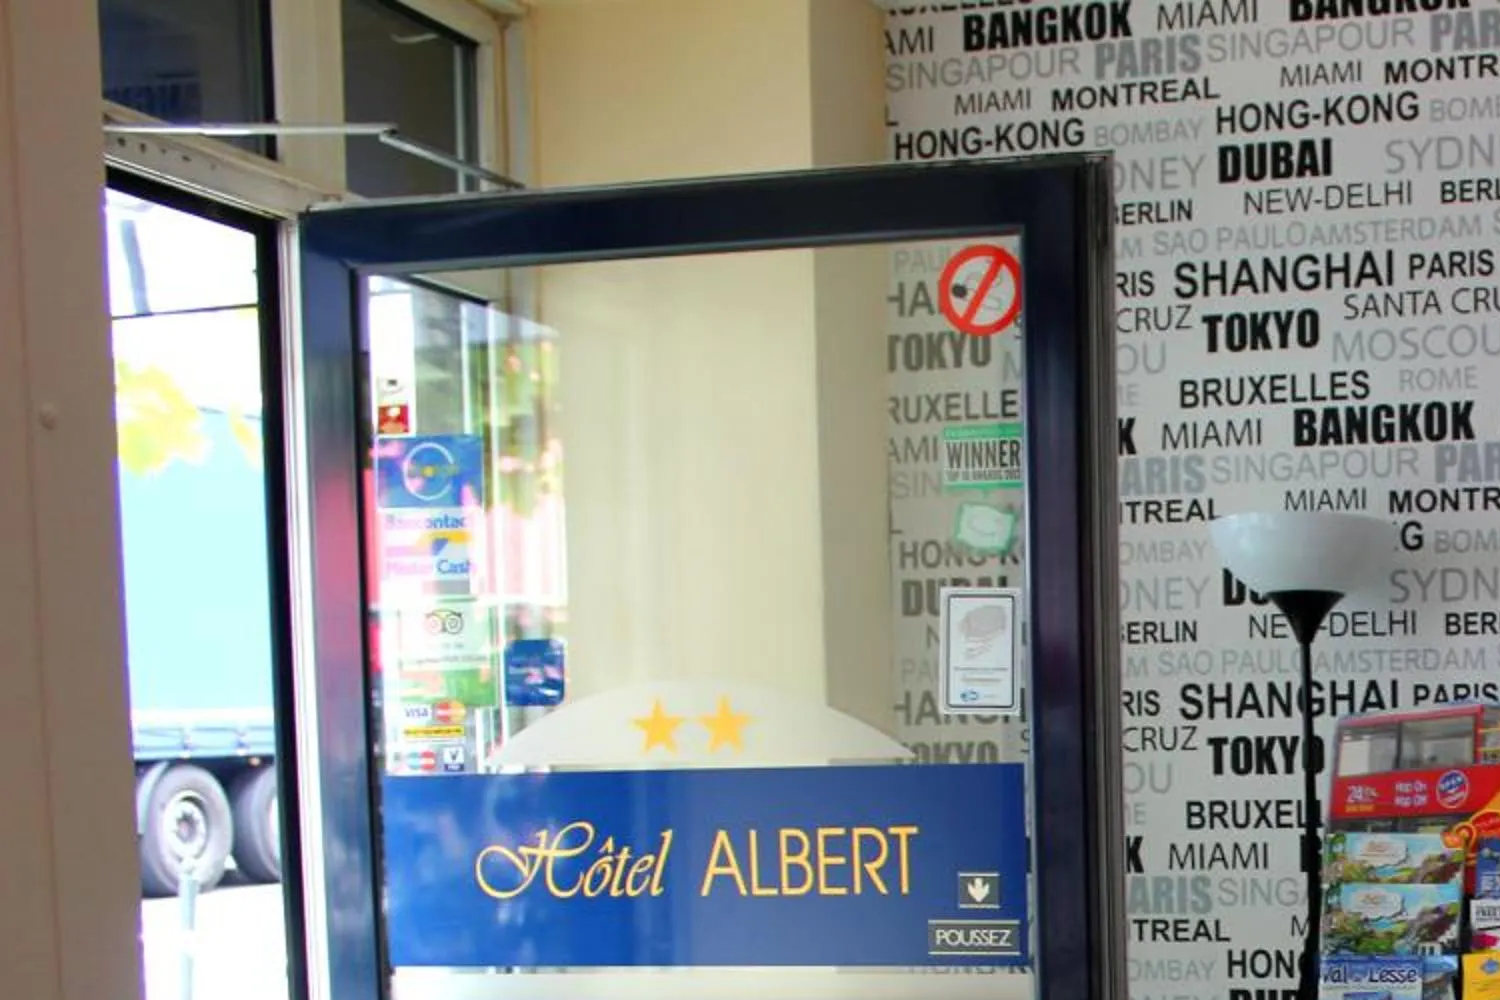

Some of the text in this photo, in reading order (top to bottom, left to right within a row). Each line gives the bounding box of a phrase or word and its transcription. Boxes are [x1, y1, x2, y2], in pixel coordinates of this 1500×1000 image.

[962, 3, 1132, 52] BANGKOK
[885, 34, 1202, 92] SINGAPOUR PARIS
[954, 87, 1032, 116] MIAMI
[1051, 78, 1220, 112] MONTREAL
[894, 118, 1085, 160] HONG-KONG
[1215, 93, 1419, 134] HONG-KONG
[1218, 138, 1332, 184] DUBAI
[1243, 180, 1412, 215] NEW-DELHI
[1173, 250, 1393, 300] SHANGHAI
[1408, 249, 1494, 280] PARIS
[1202, 309, 1319, 354] TOKYO
[1179, 371, 1370, 409] BRUXELLES
[1400, 366, 1478, 393] ROME
[1162, 402, 1475, 448] MIAMI BANGKOK
[946, 440, 1020, 468] WINNER
[1210, 446, 1419, 485] SINGAPOUR
[1285, 488, 1367, 513] MIAMI
[1180, 678, 1399, 723] SHANGHAI
[1208, 734, 1325, 777] TOKYO
[475, 821, 919, 898] Hôtel ALBERT
[1169, 842, 1269, 871] MIAMI
[934, 928, 1011, 947] POUSSEZ
[1368, 964, 1417, 983] Lesse
